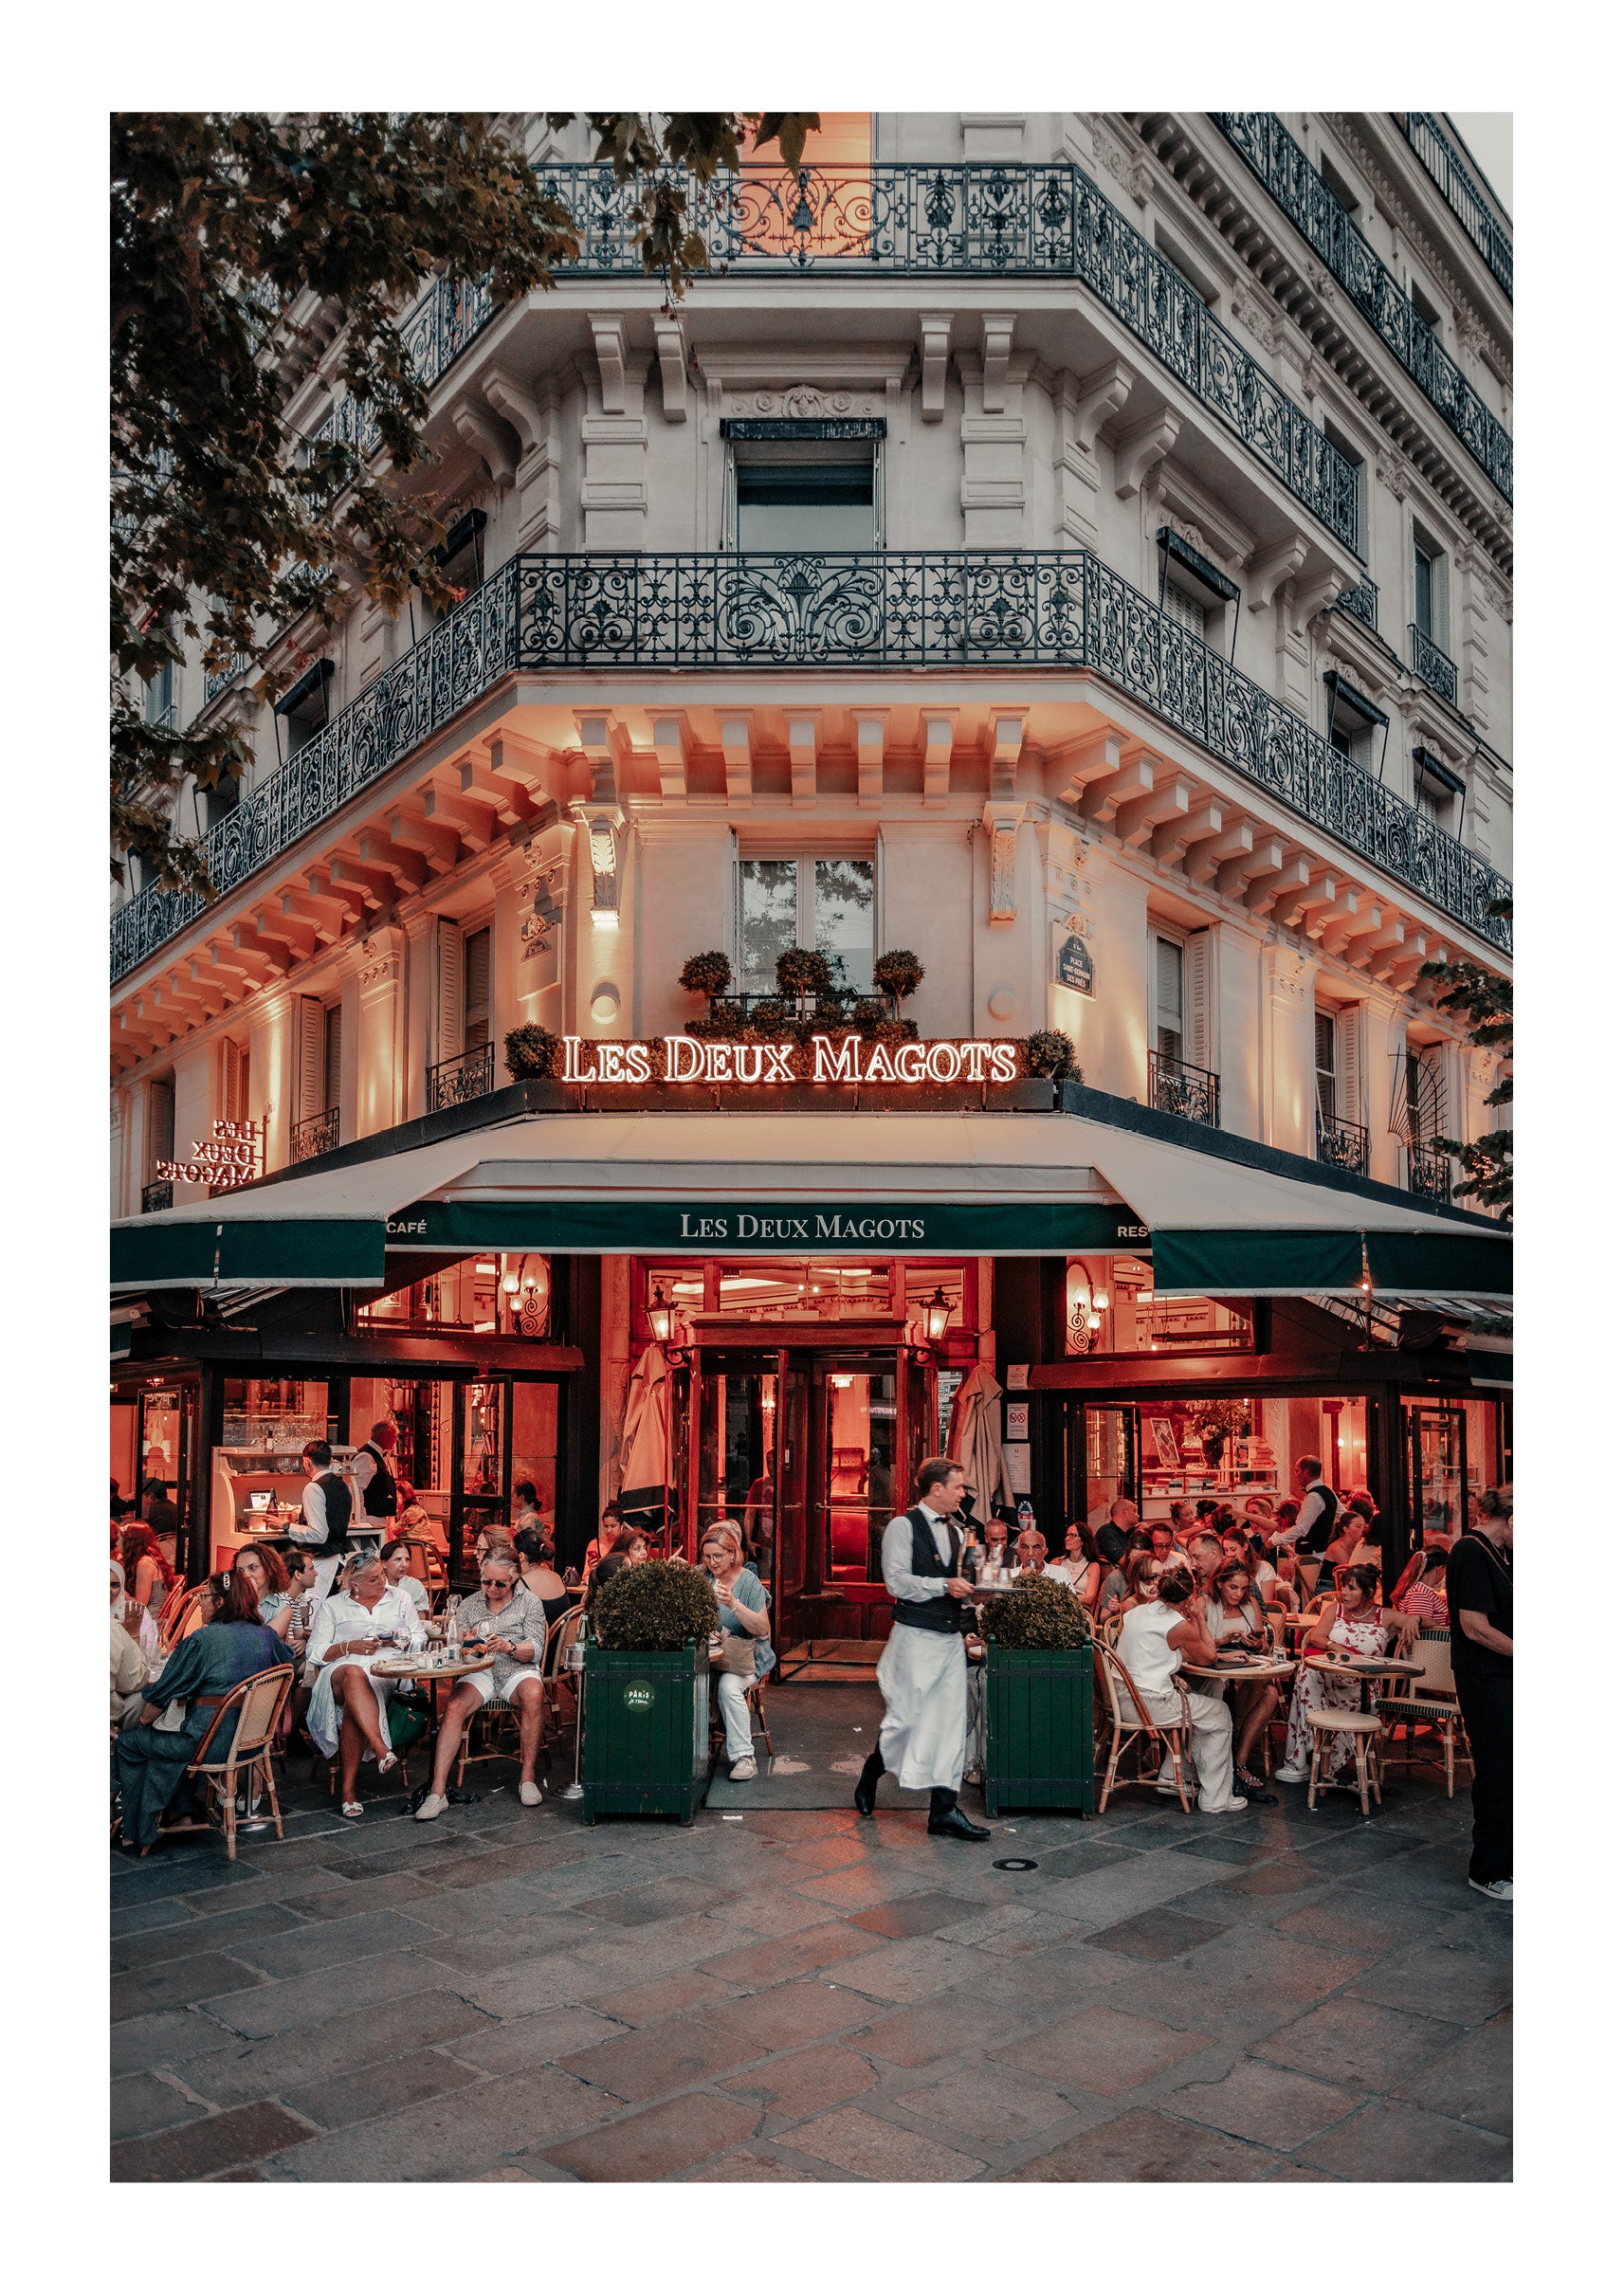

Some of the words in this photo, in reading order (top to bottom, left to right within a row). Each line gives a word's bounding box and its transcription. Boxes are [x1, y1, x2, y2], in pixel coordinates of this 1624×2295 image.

[1069, 956, 1083, 968] PLACE
[1067, 974, 1075, 984] DES
[1075, 976, 1086, 988] PRÉS
[562, 1036, 651, 1083] LES
[664, 1036, 795, 1083] DEUX
[812, 1035, 1016, 1083] MAGOTS
[386, 1219, 427, 1233] CAFÉ
[680, 1213, 728, 1238] LES
[737, 1214, 809, 1238] DEUX
[814, 1214, 925, 1238] MAGOTS
